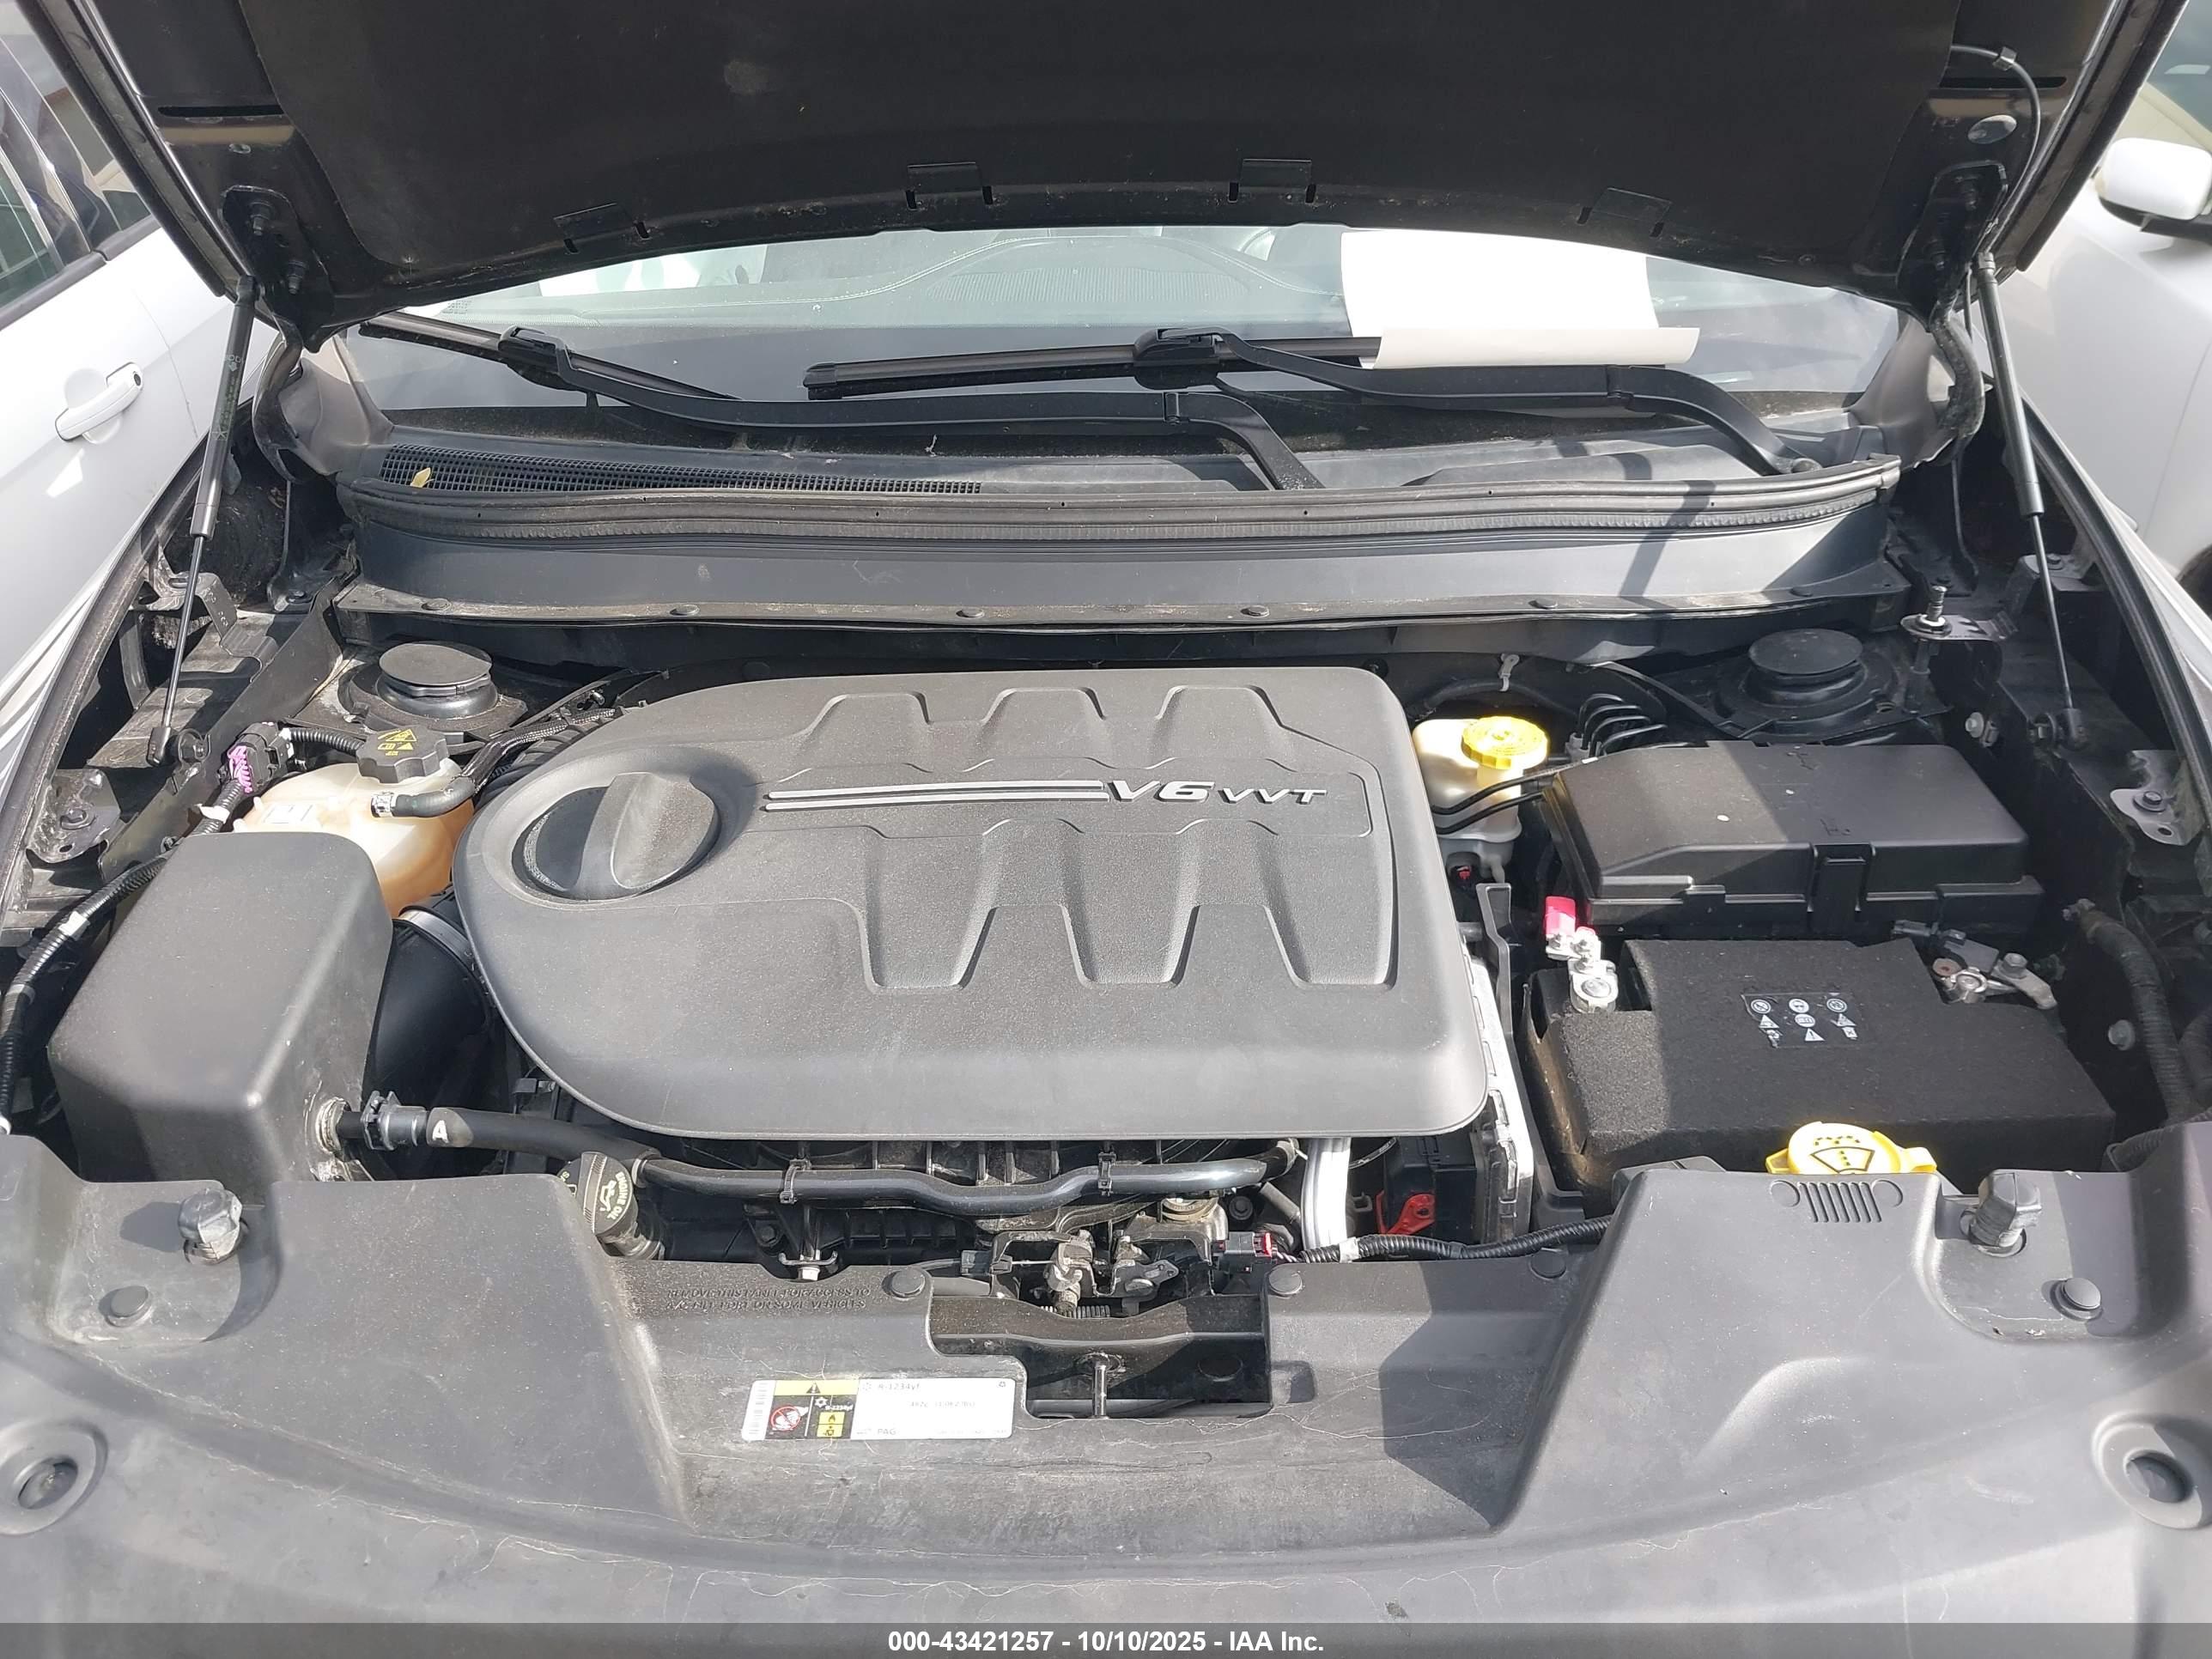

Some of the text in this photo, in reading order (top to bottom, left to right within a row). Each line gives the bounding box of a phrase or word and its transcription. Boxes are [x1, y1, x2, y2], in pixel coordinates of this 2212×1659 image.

[1111, 780, 1328, 804] V6 VVT
[432, 1120, 449, 1144] A
[606, 1171, 629, 1220] ENGINE OIL
